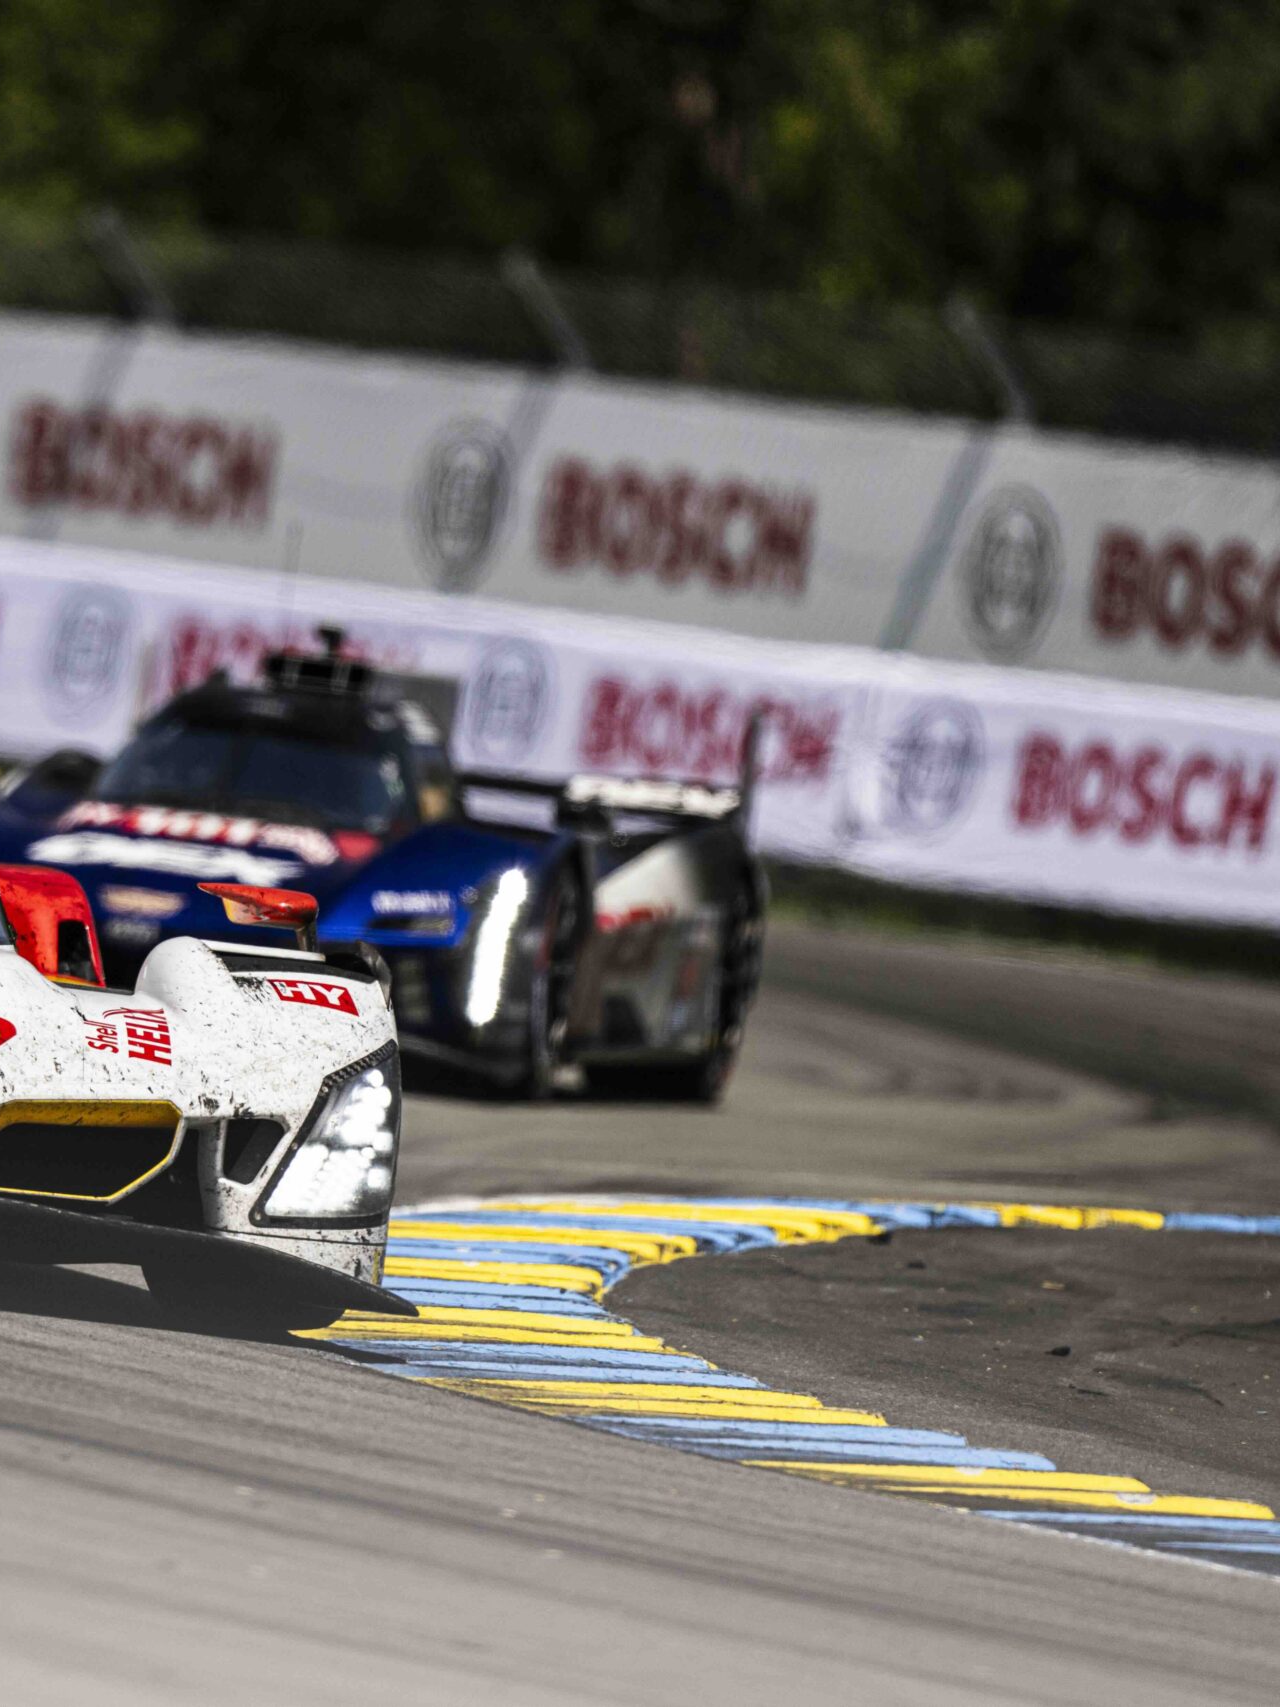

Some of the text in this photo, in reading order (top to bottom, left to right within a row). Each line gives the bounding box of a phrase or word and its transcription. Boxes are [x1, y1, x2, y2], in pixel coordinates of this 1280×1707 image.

[8, 393, 281, 527] BOSCH
[537, 455, 816, 600] BOSCH
[1012, 729, 1276, 857] BOSCH
[83, 1019, 120, 1054] Shell
[118, 1006, 173, 1067] HELIX
[273, 981, 346, 1006] HY
